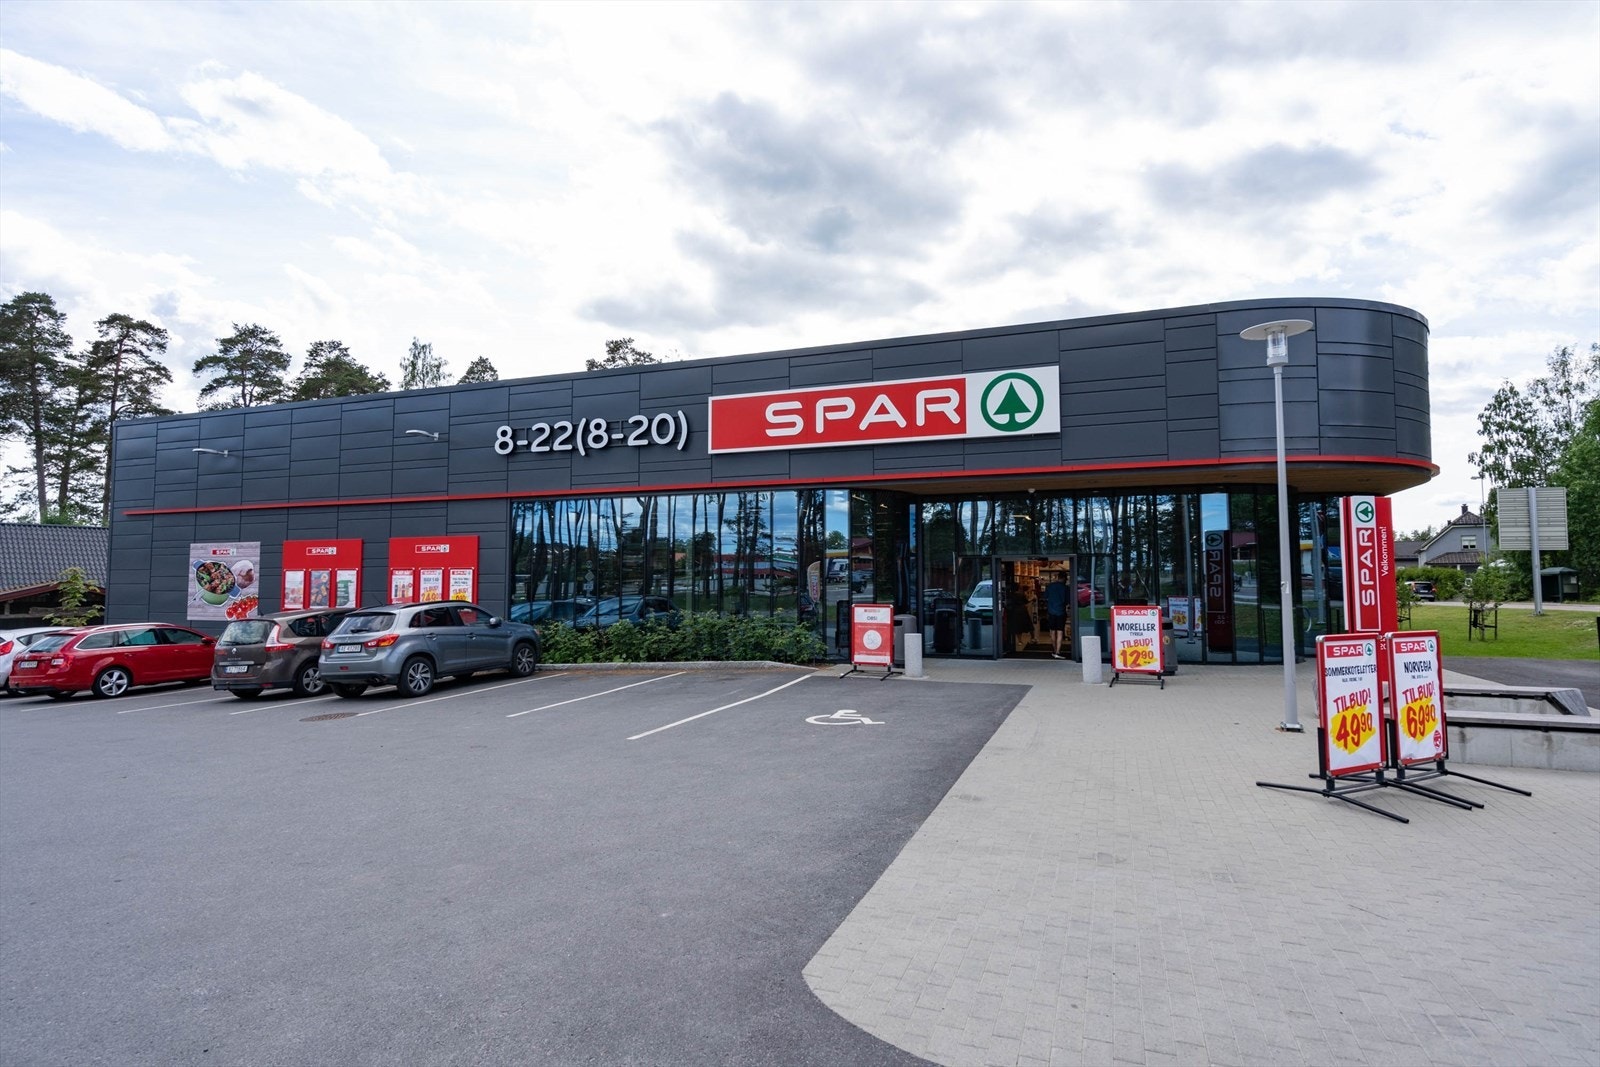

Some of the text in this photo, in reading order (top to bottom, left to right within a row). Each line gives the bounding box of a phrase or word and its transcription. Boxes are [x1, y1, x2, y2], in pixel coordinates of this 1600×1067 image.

[765, 387, 961, 437] SPAR
[1379, 526, 1389, 577] Velkommen!
[1359, 529, 1375, 606] SPAR
[1117, 622, 1156, 632] MORELLER
[1120, 637, 1154, 649] TILBUD!
[1333, 645, 1363, 656] SPAR
[1400, 642, 1427, 652] SPAR
[1333, 688, 1372, 713] TILBUD!
[1402, 681, 1436, 704] TILBUD!
